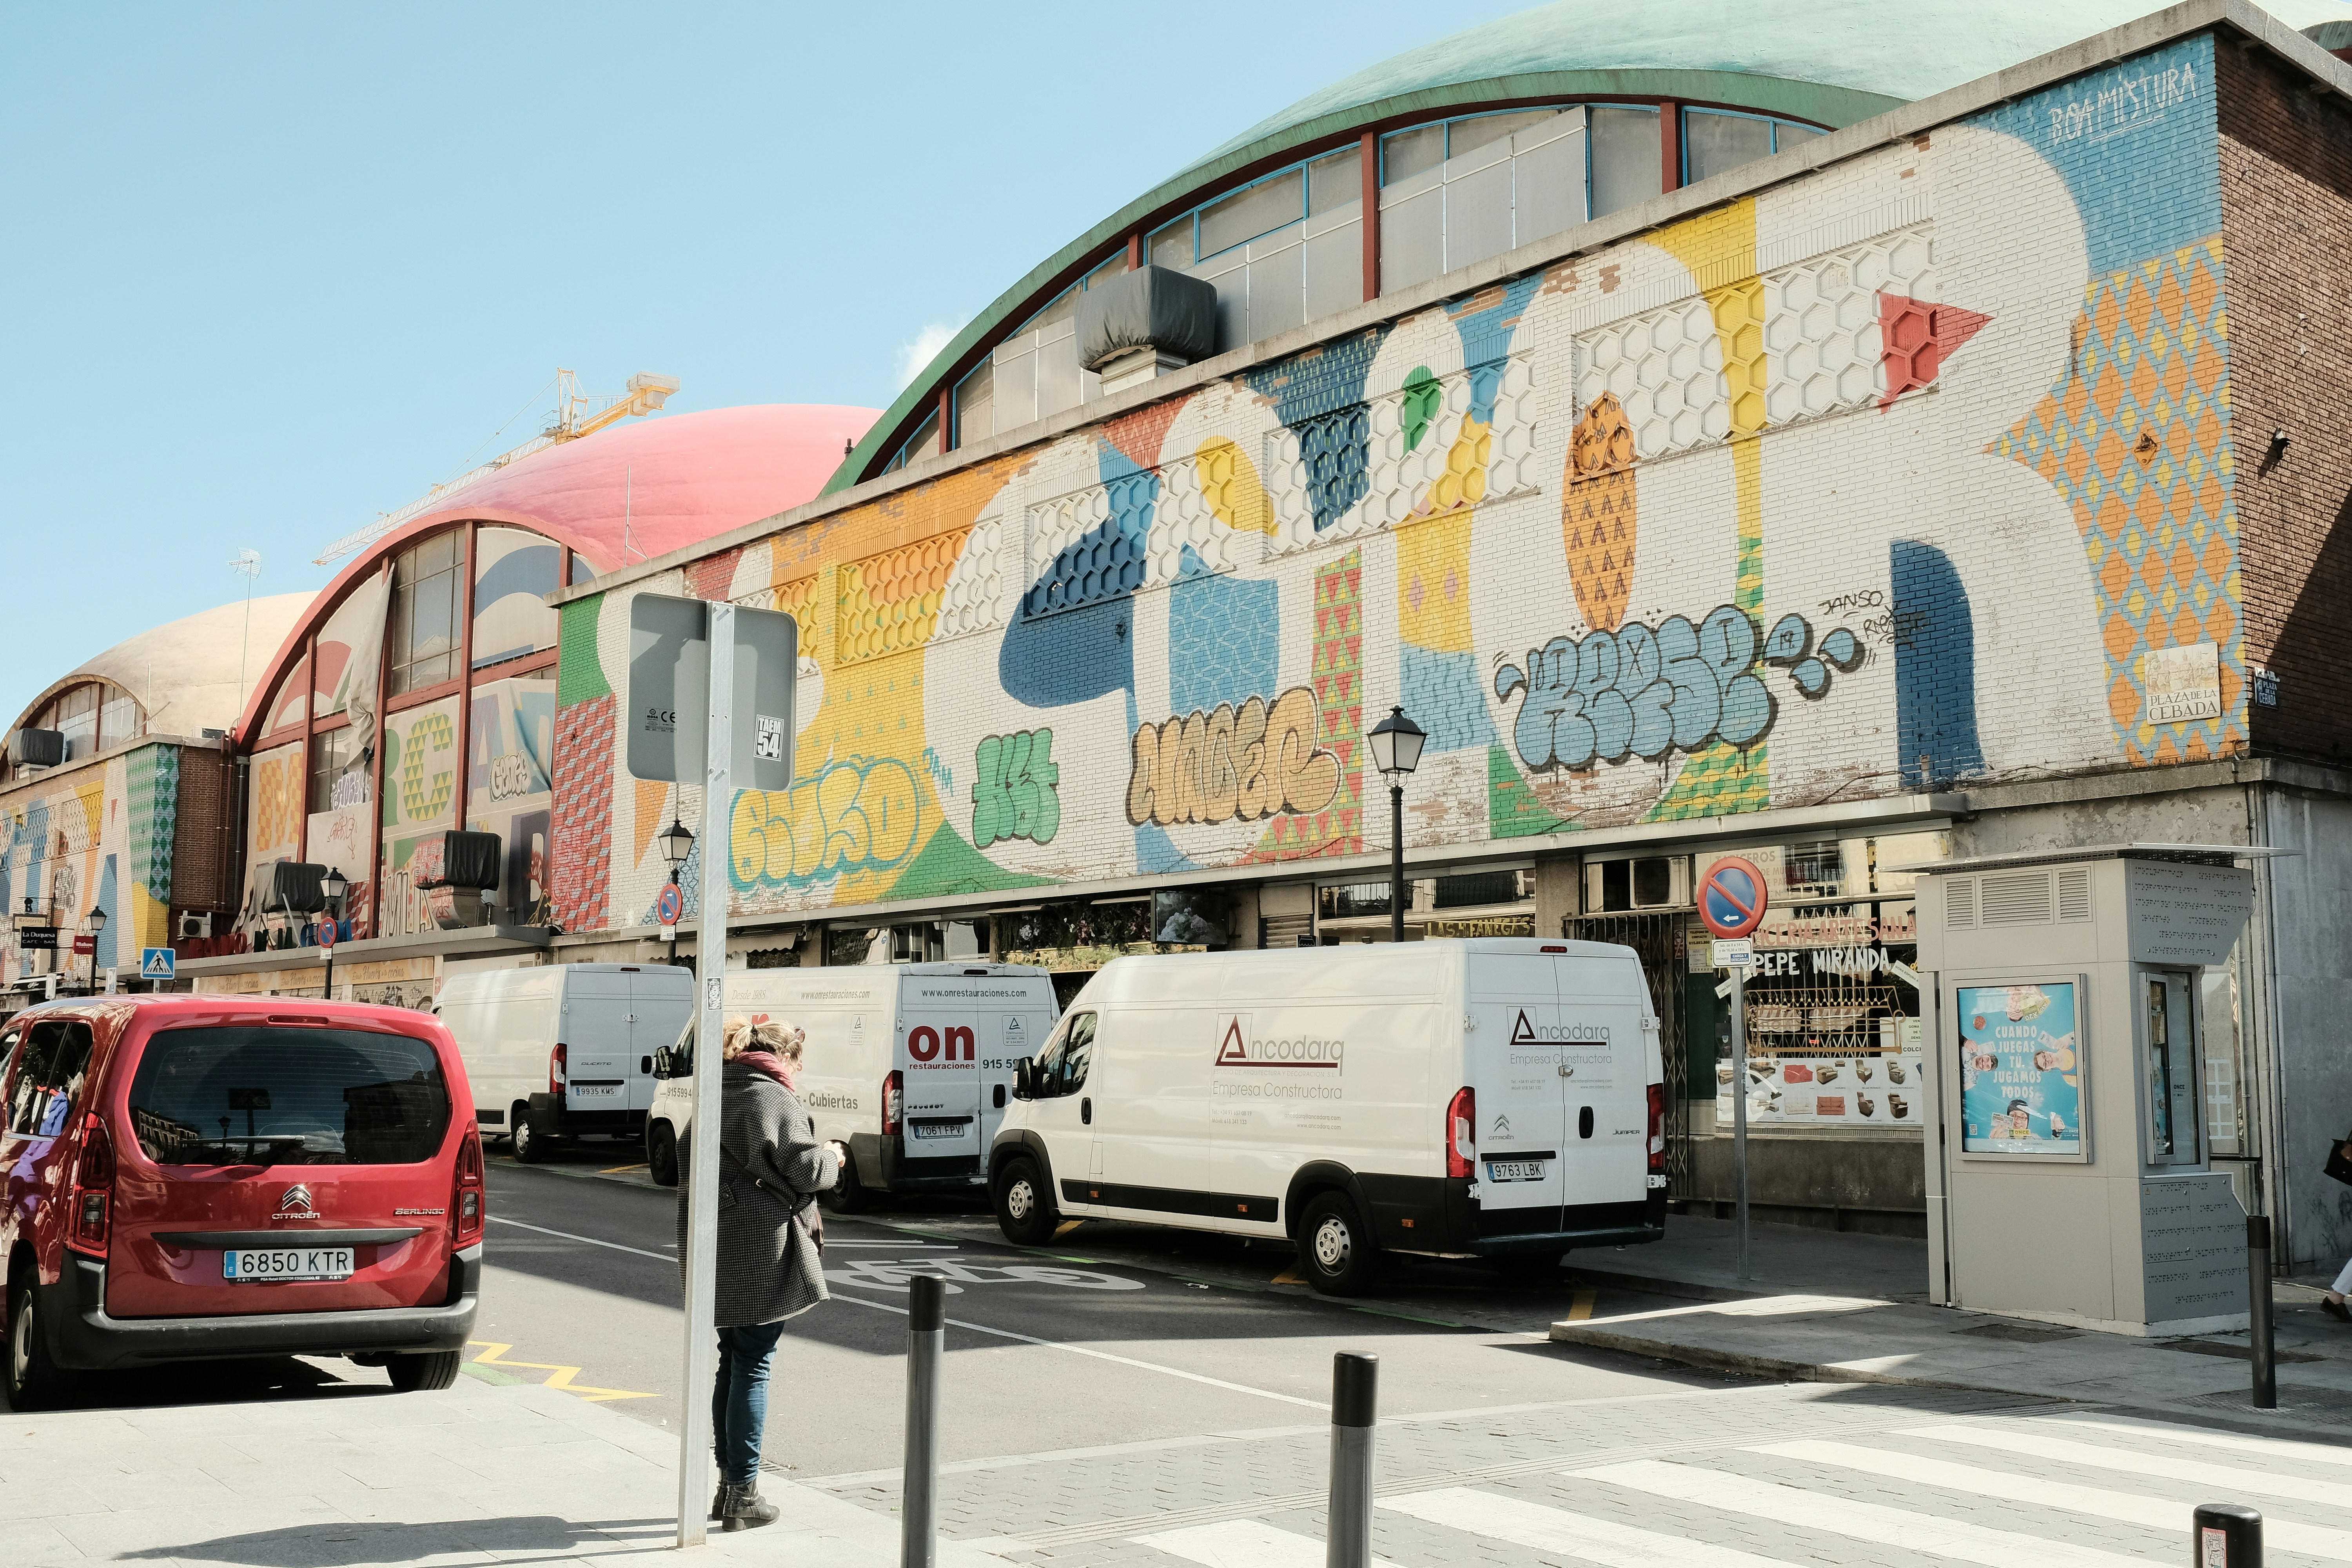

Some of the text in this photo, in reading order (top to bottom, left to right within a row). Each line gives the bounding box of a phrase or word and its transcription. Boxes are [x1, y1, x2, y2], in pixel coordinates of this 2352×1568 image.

[2048, 98, 2093, 147] BOA
[2263, 681, 2277, 691] PLAZA
[2150, 689, 2217, 706] PLAZA DE LA
[2259, 692, 2276, 706] CEBADA
[2149, 700, 2219, 720] CEBADA
[759, 717, 781, 734] TAEM
[757, 731, 779, 757] 54
[1752, 947, 1891, 977] PEPE MIRANDA
[731, 989, 766, 1000] Desde 1988
[801, 989, 870, 1000] www.onrestauraciones.com
[921, 988, 1027, 998] www.onrestauraciones.com
[1995, 1025, 2037, 1039] CUANDO
[908, 1025, 975, 1062] on
[1998, 1041, 2035, 1053] JUEGAS
[983, 1059, 1002, 1069] 915
[1510, 1054, 1612, 1067] Empresa Constructora
[1993, 1071, 2042, 1083] JUGAMOS
[1213, 1081, 1342, 1100] Empresa Constructora
[2001, 1085, 2034, 1099] TODOS
[809, 1092, 858, 1110] Cubiertas
[920, 1125, 962, 1136] 7061 FPV
[1296, 1122, 1341, 1131] www.ancodarq.com
[1495, 1163, 1542, 1177] 9763 LBK
[272, 1211, 320, 1220] CITROËN
[242, 1252, 348, 1273] 6850 KTR
